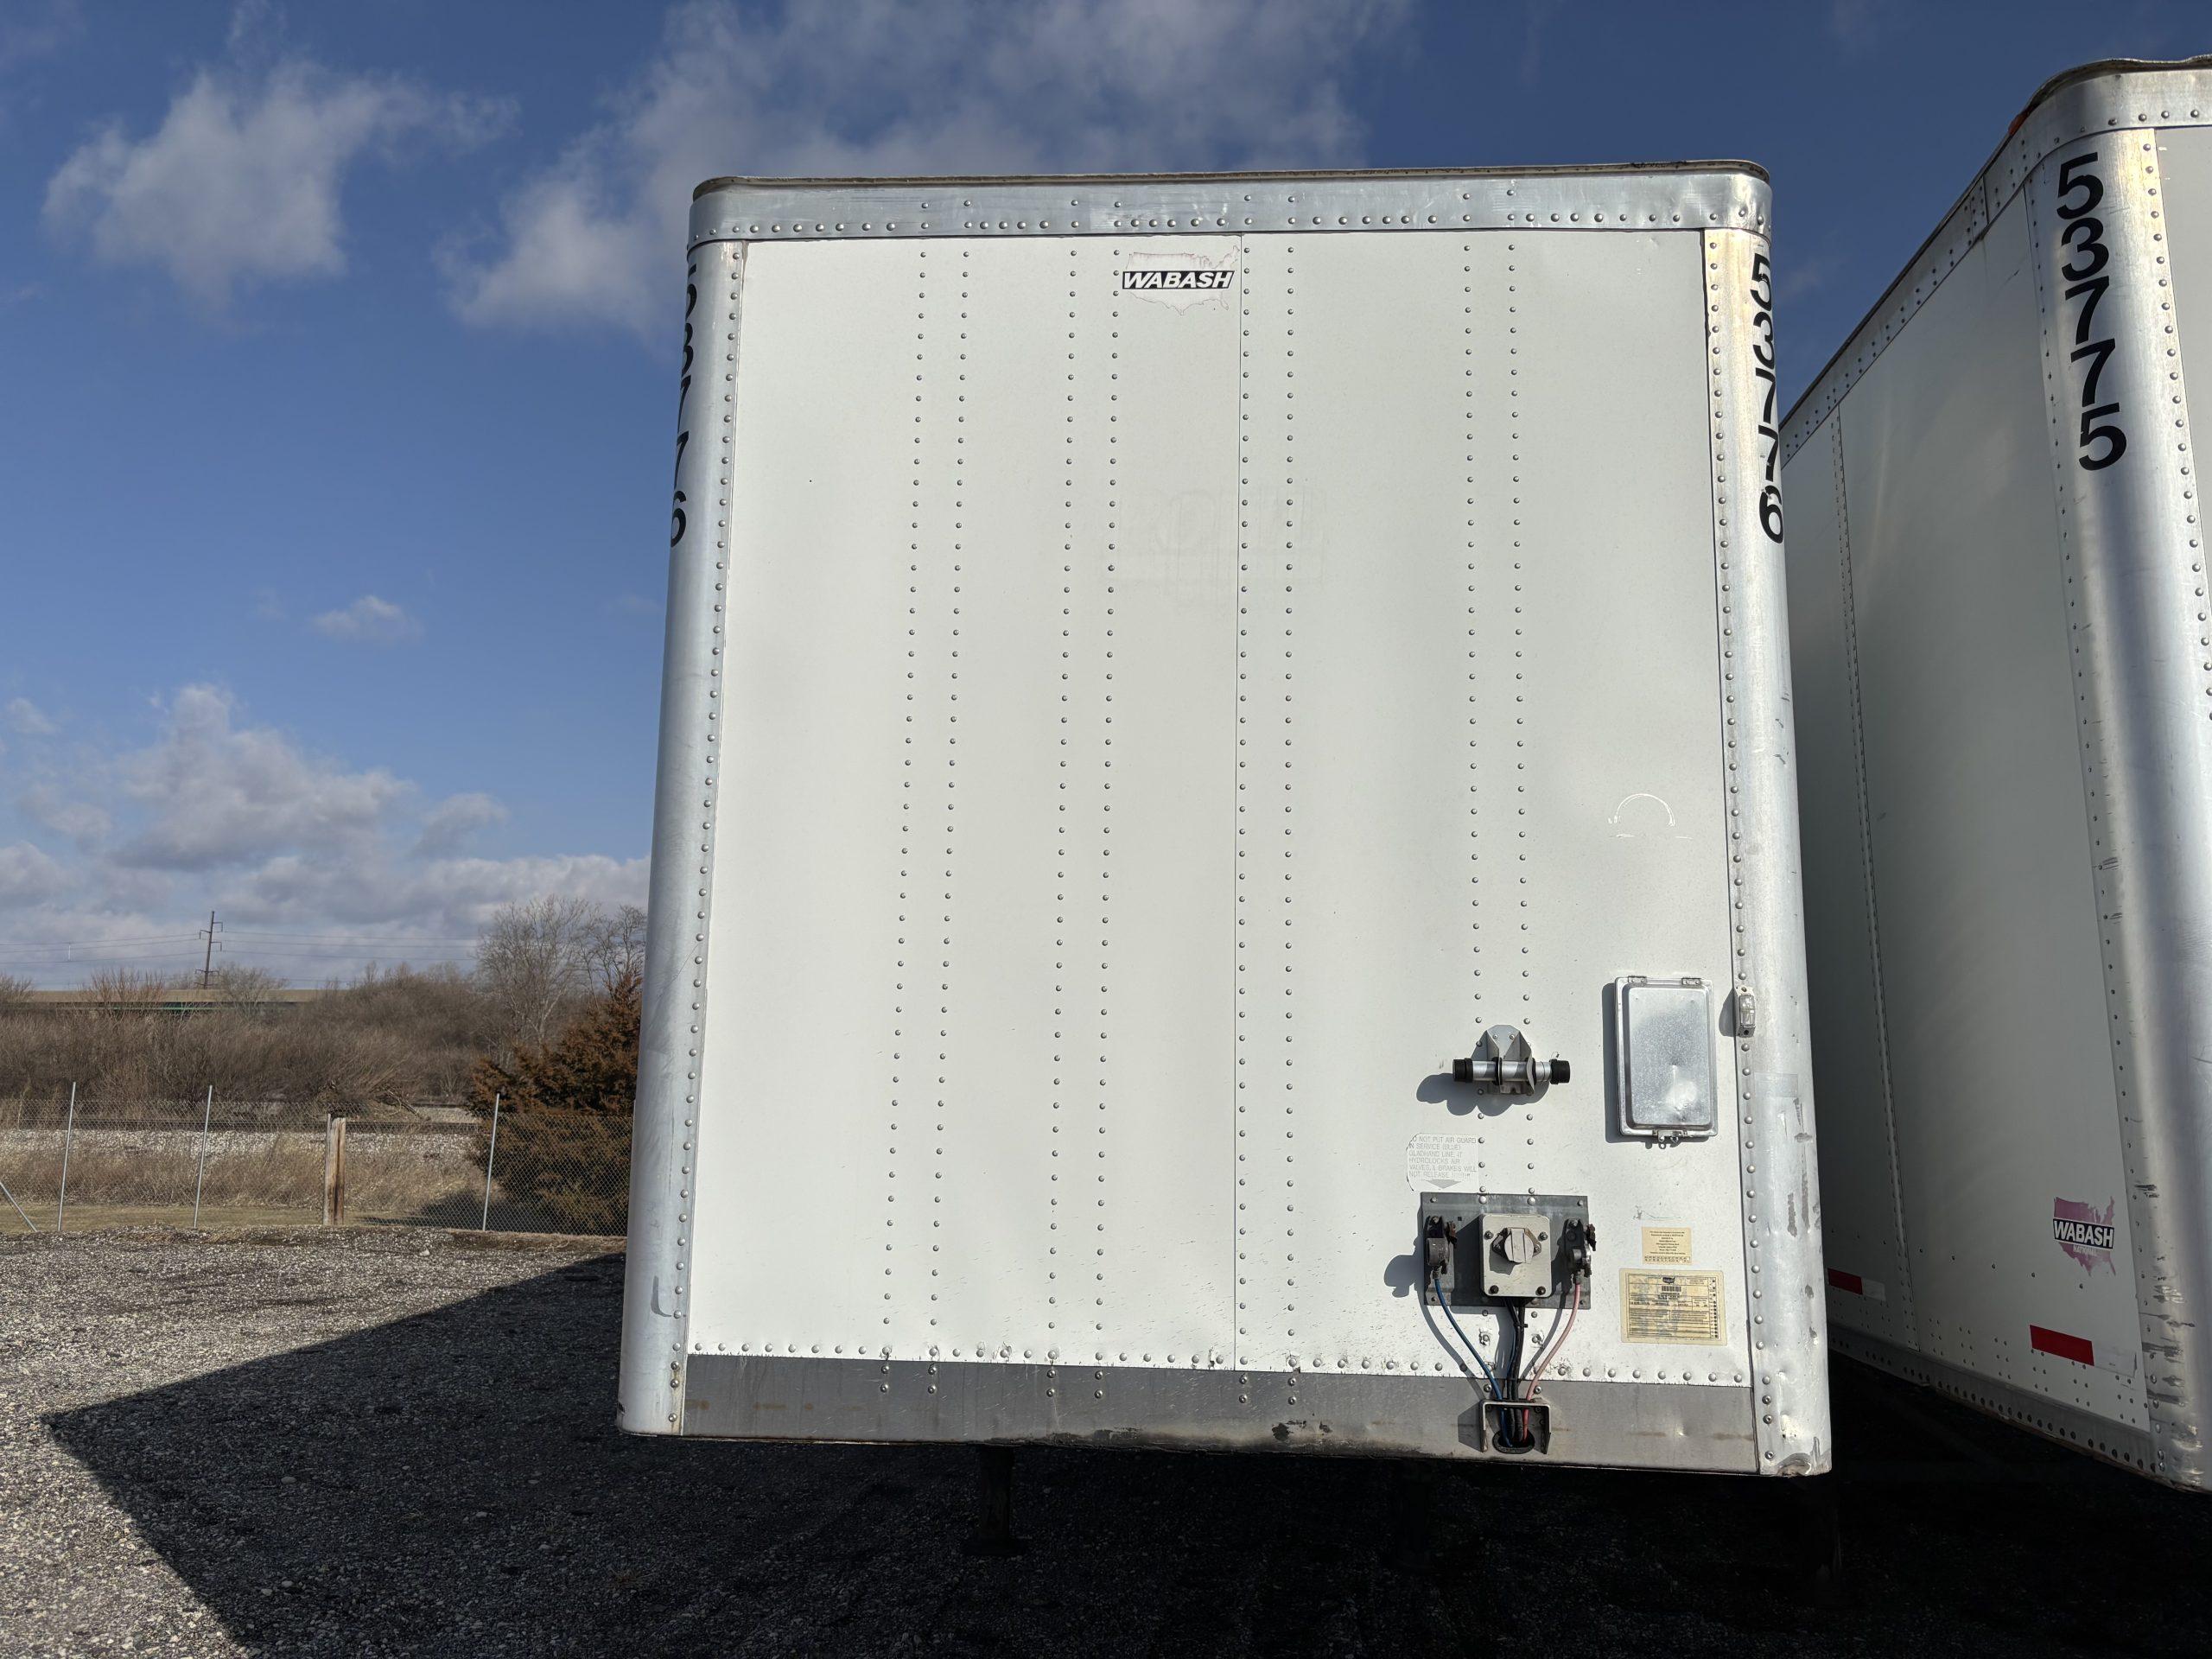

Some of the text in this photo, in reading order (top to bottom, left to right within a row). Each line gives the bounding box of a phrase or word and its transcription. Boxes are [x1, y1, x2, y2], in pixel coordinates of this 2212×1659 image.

[1123, 271, 1233, 289] WABASH
[2056, 152, 2127, 472] 53775
[1750, 253, 1783, 544] 53776
[2054, 1220, 2113, 1249] WABASH
